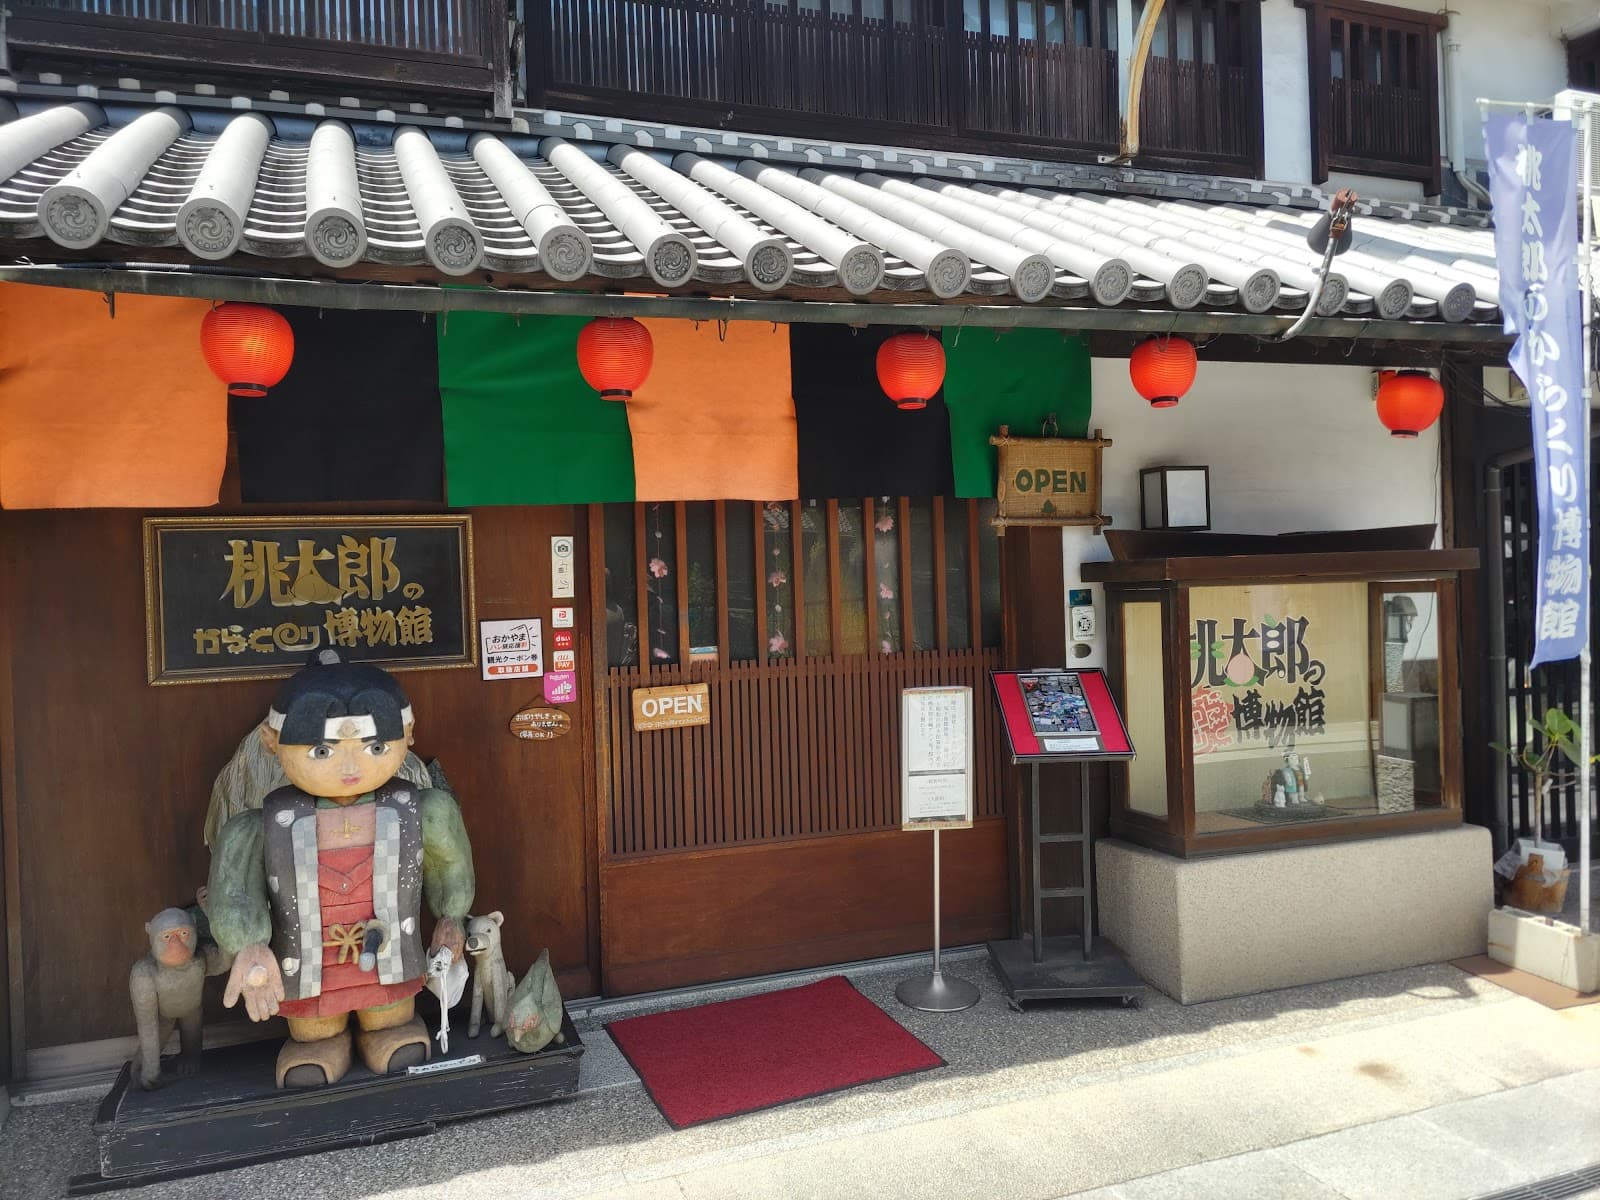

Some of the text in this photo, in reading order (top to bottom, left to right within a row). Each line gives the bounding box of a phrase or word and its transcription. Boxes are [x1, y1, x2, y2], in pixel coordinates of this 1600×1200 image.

[1015, 468, 1087, 494] OPEN
[218, 535, 425, 609] 桃太郎の
[491, 633, 526, 644] おかやま
[487, 654, 538, 664] 観光クーポン券
[641, 694, 703, 718] OPEN
[1230, 685, 1327, 749] 博物館
